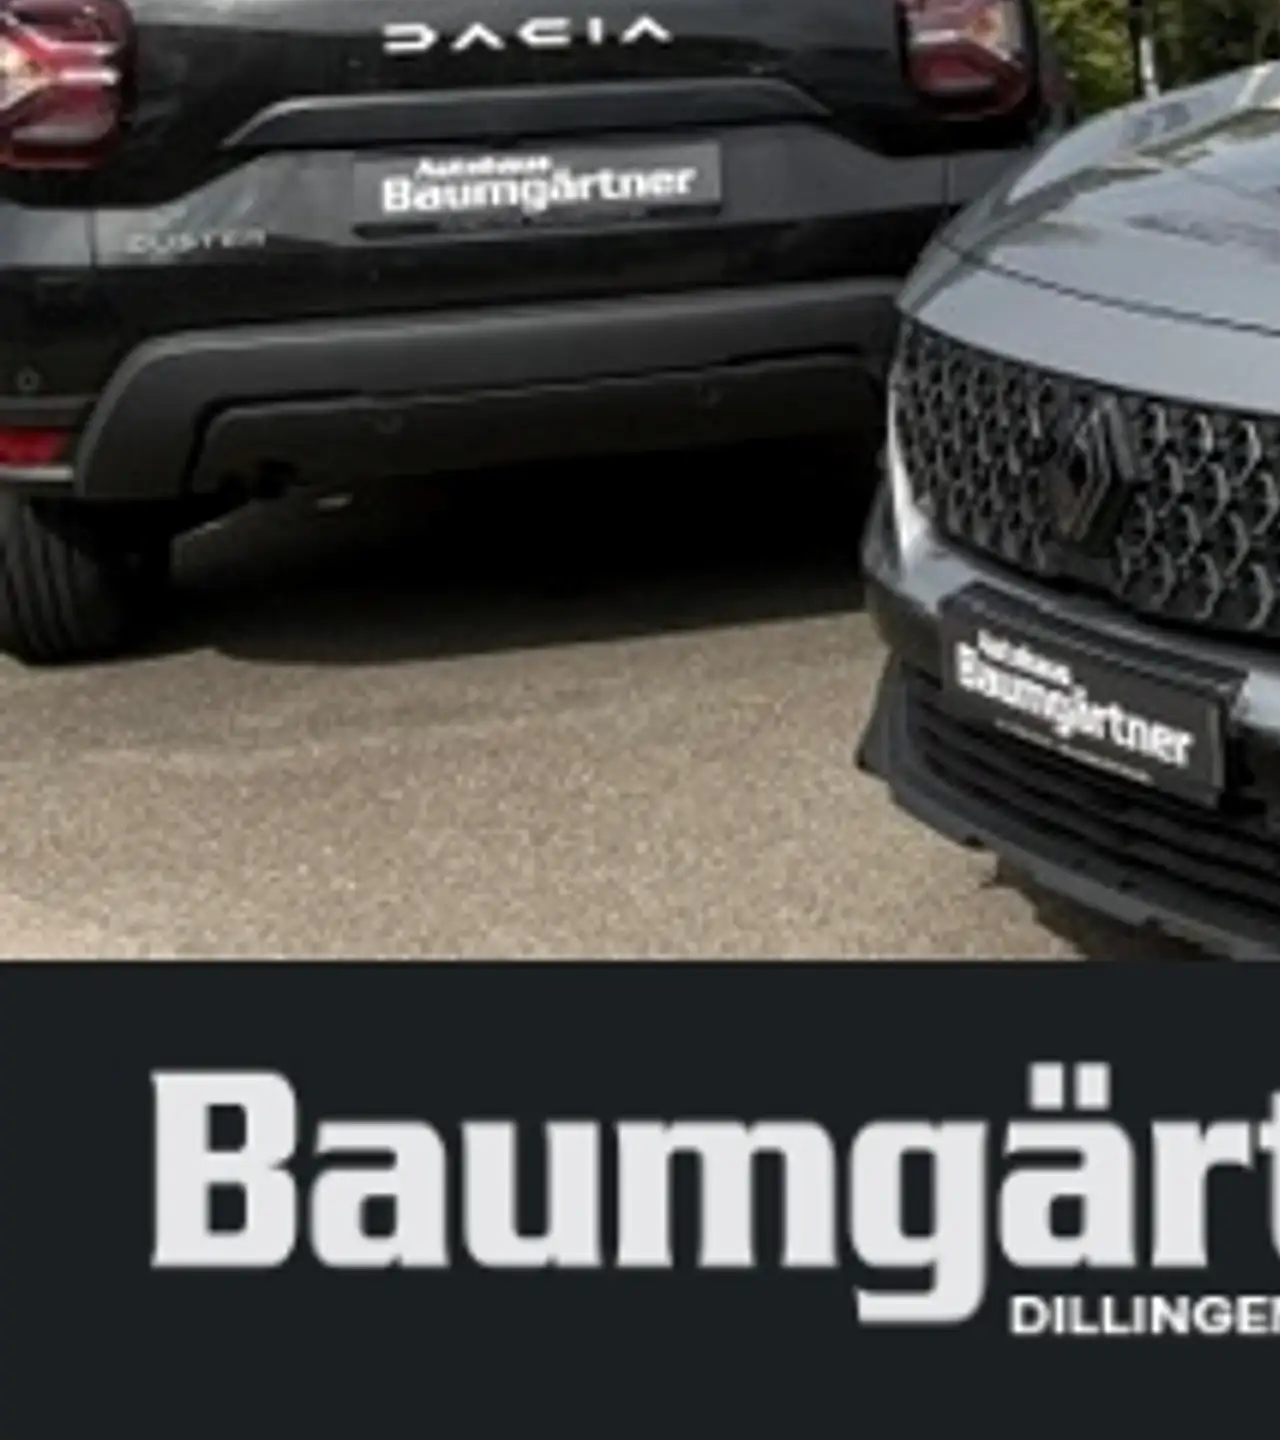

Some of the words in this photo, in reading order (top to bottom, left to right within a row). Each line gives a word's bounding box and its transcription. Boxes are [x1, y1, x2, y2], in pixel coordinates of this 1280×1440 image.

[383, 15, 673, 55] DACIA
[381, 166, 697, 215] Baumgärtner
[955, 641, 1196, 768] Baumgärtner
